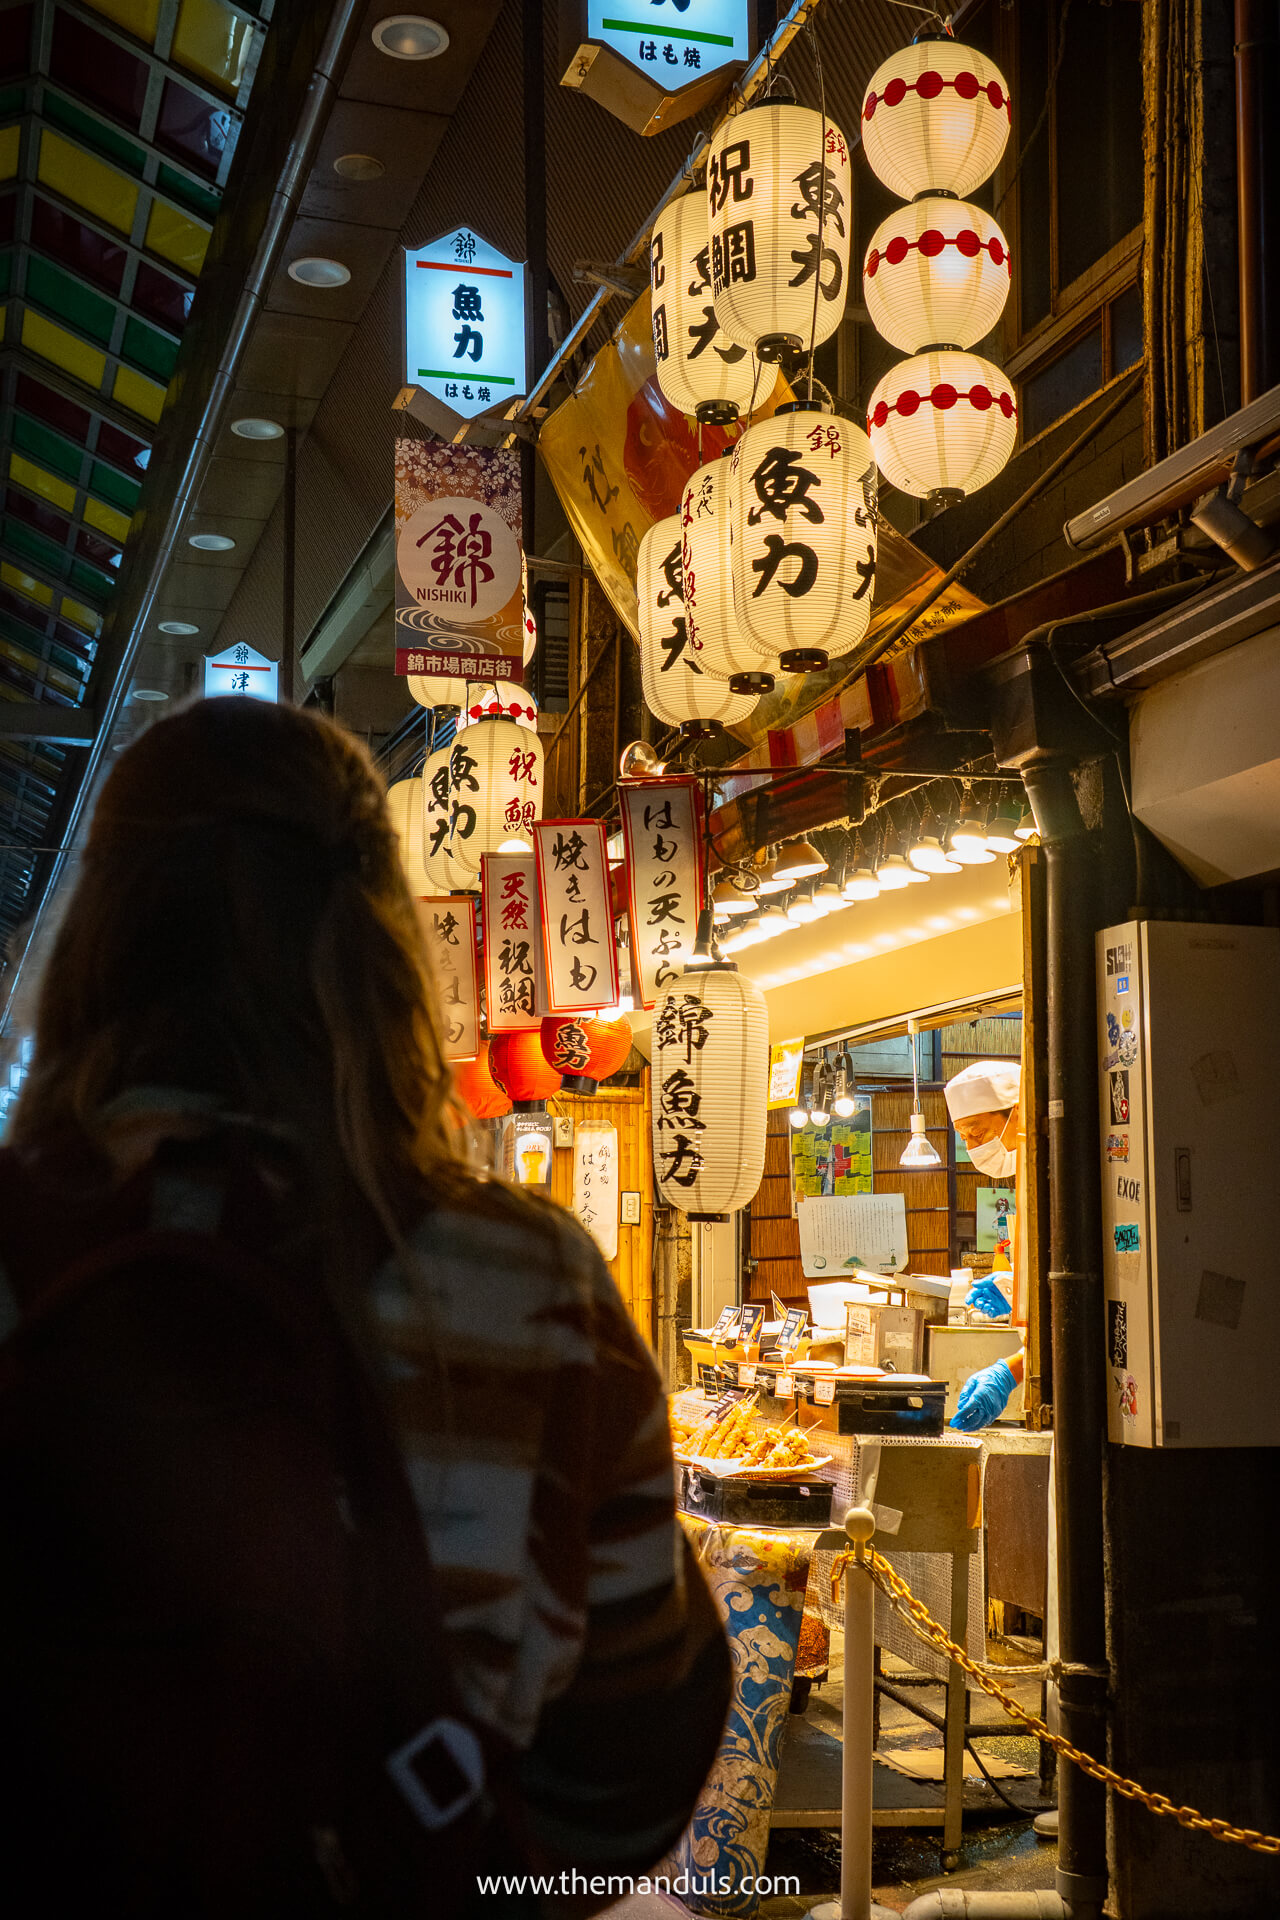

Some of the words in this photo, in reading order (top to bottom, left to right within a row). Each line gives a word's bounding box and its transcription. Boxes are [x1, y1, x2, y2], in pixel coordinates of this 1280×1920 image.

[639, 40, 702, 70] はも焼
[823, 128, 848, 167] 錦
[450, 232, 477, 264] 錦
[709, 139, 757, 300] 祝鯛
[788, 161, 847, 302] 魚力
[451, 283, 485, 363] 魚力
[445, 382, 492, 402] はも焼
[806, 424, 842, 459] 錦
[416, 512, 495, 609] 錦
[747, 446, 825, 599] 魚力
[416, 587, 467, 604] NISHIKI
[231, 671, 250, 692] 津
[233, 645, 249, 665] 錦
[407, 653, 513, 678] 錦市場商店街
[449, 744, 480, 840] 魚力
[503, 747, 538, 837] 祝鯛
[499, 871, 530, 931] 天然
[552, 830, 600, 993] 焼きはも
[644, 800, 686, 989] はもの天ぷら
[498, 939, 537, 1018] 祝鯛
[656, 994, 714, 1188] 錦魚力
